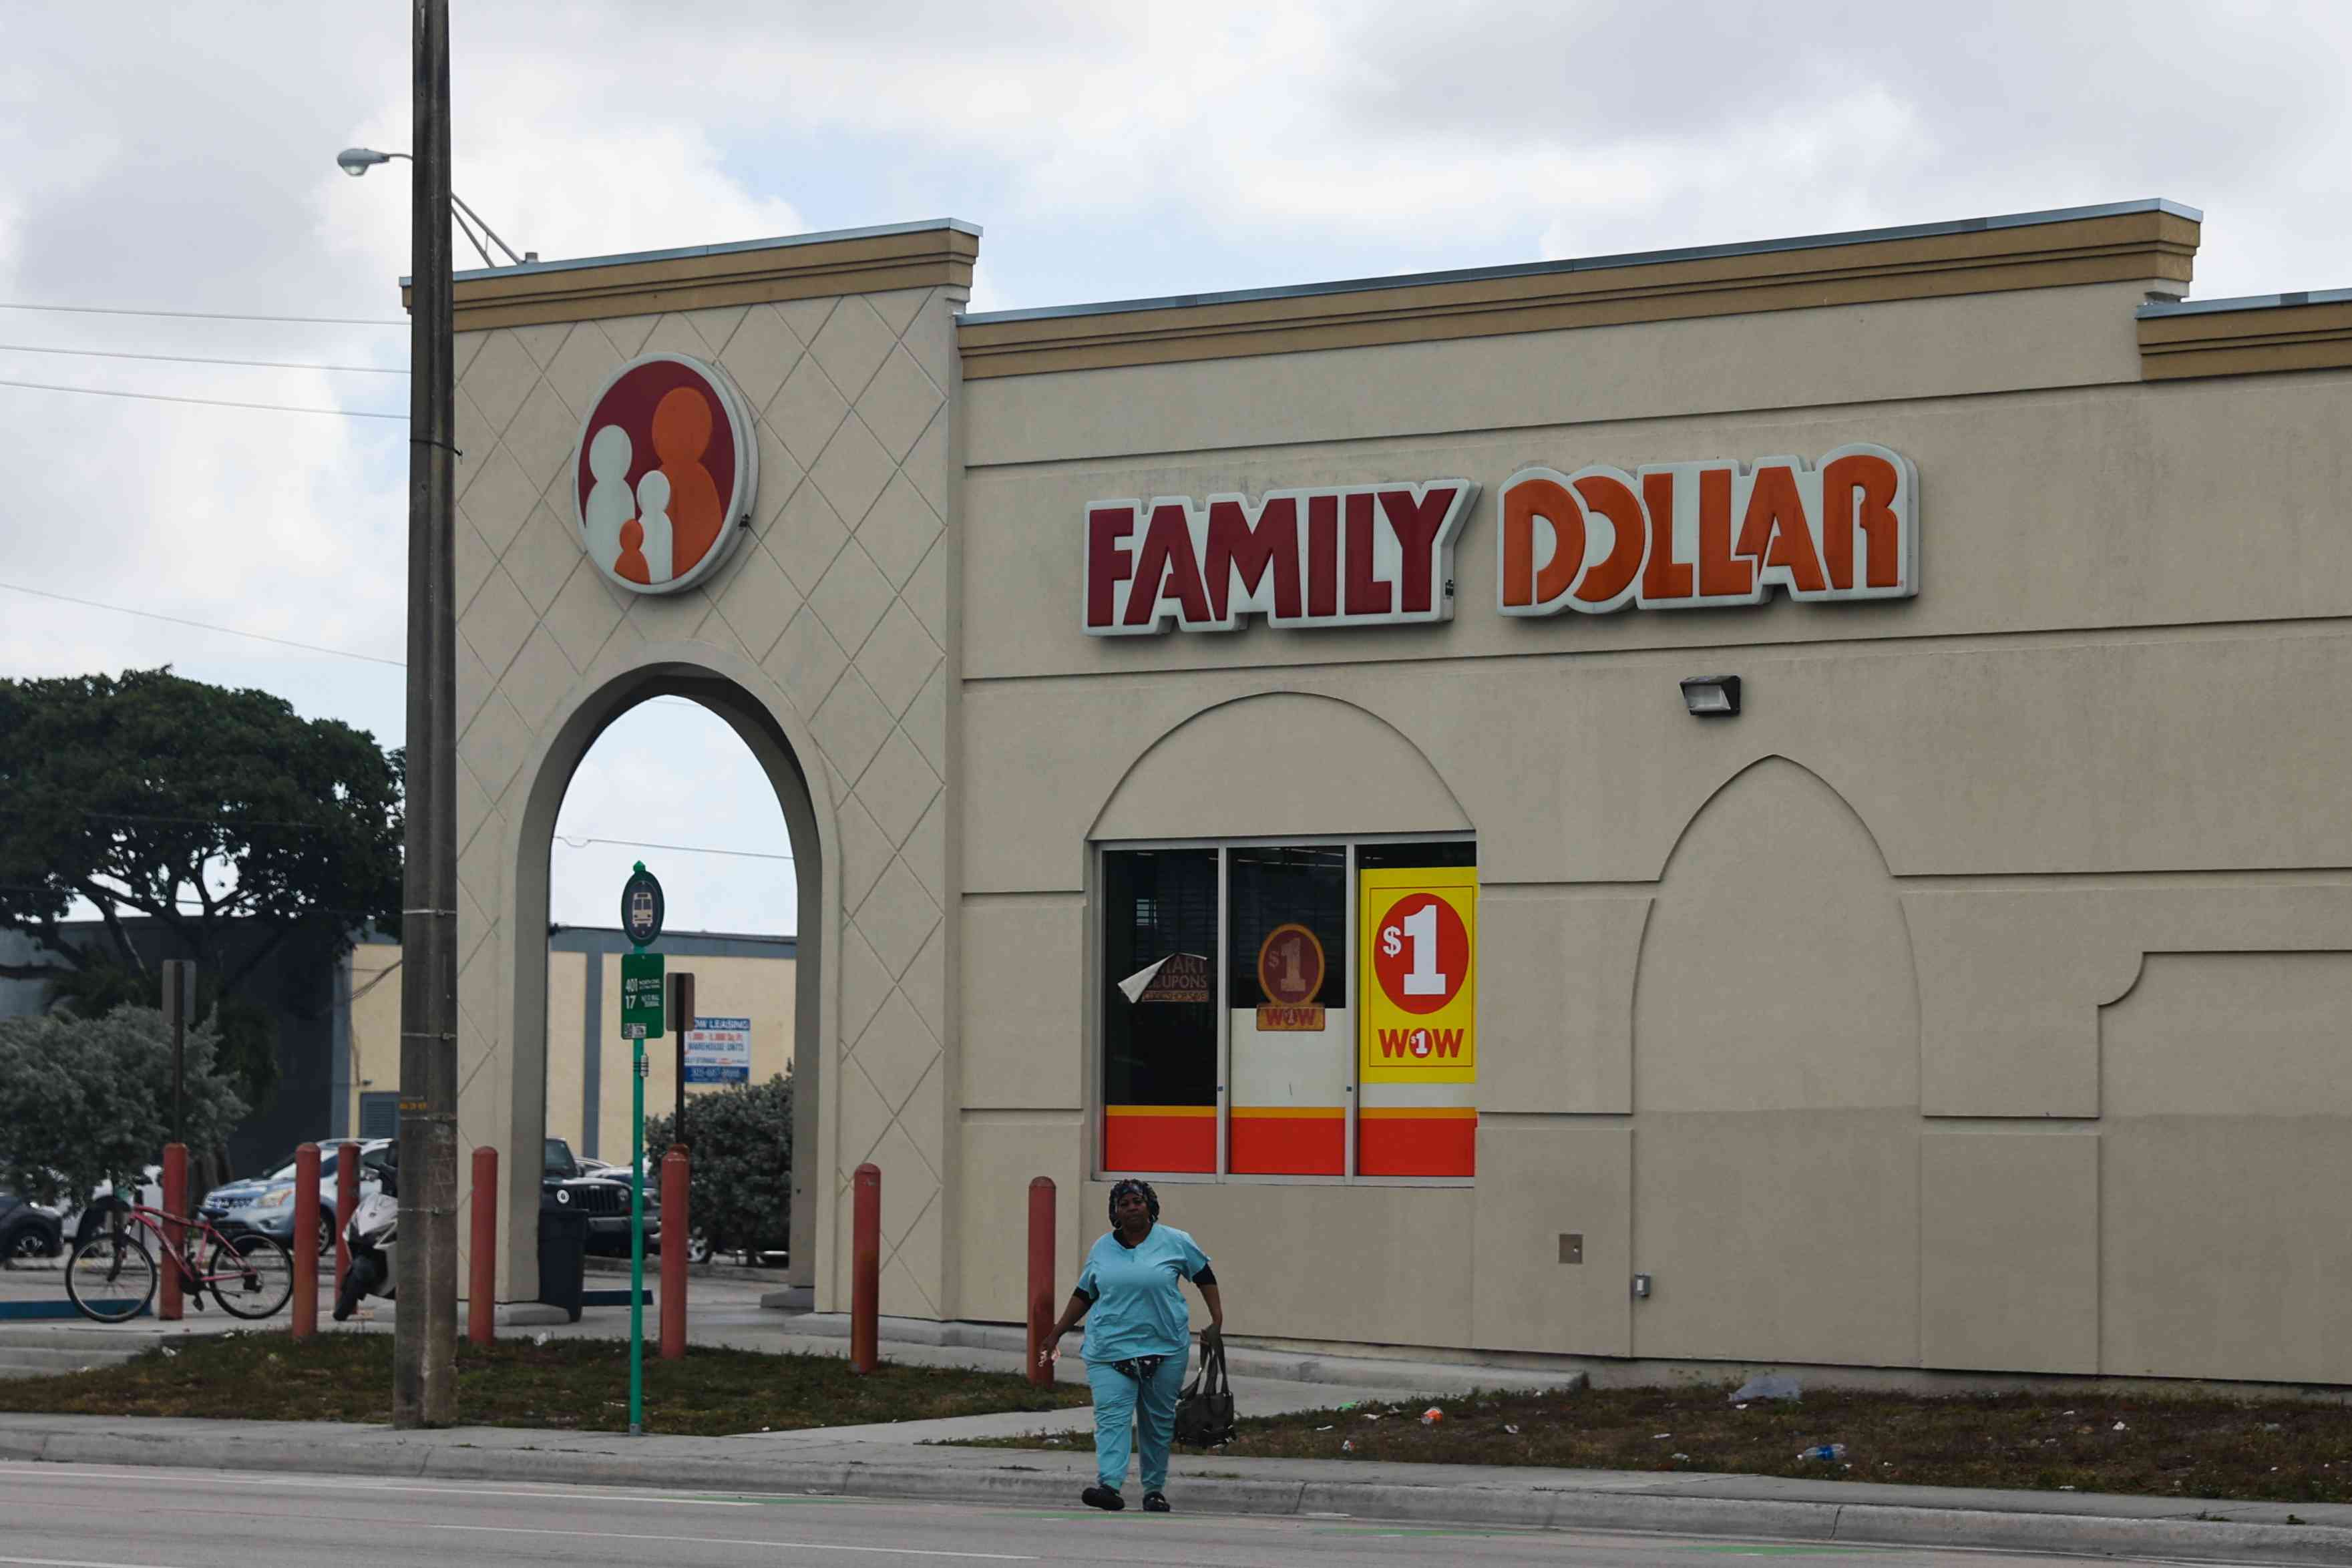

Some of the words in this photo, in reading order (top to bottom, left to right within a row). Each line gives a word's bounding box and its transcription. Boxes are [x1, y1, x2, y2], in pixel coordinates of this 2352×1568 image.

[1088, 487, 1459, 628] FAMILY
[1501, 455, 1900, 606] DOLLAR
[1267, 936, 1307, 992] $1
[1382, 904, 1446, 996] $1
[625, 995, 636, 1010] 17
